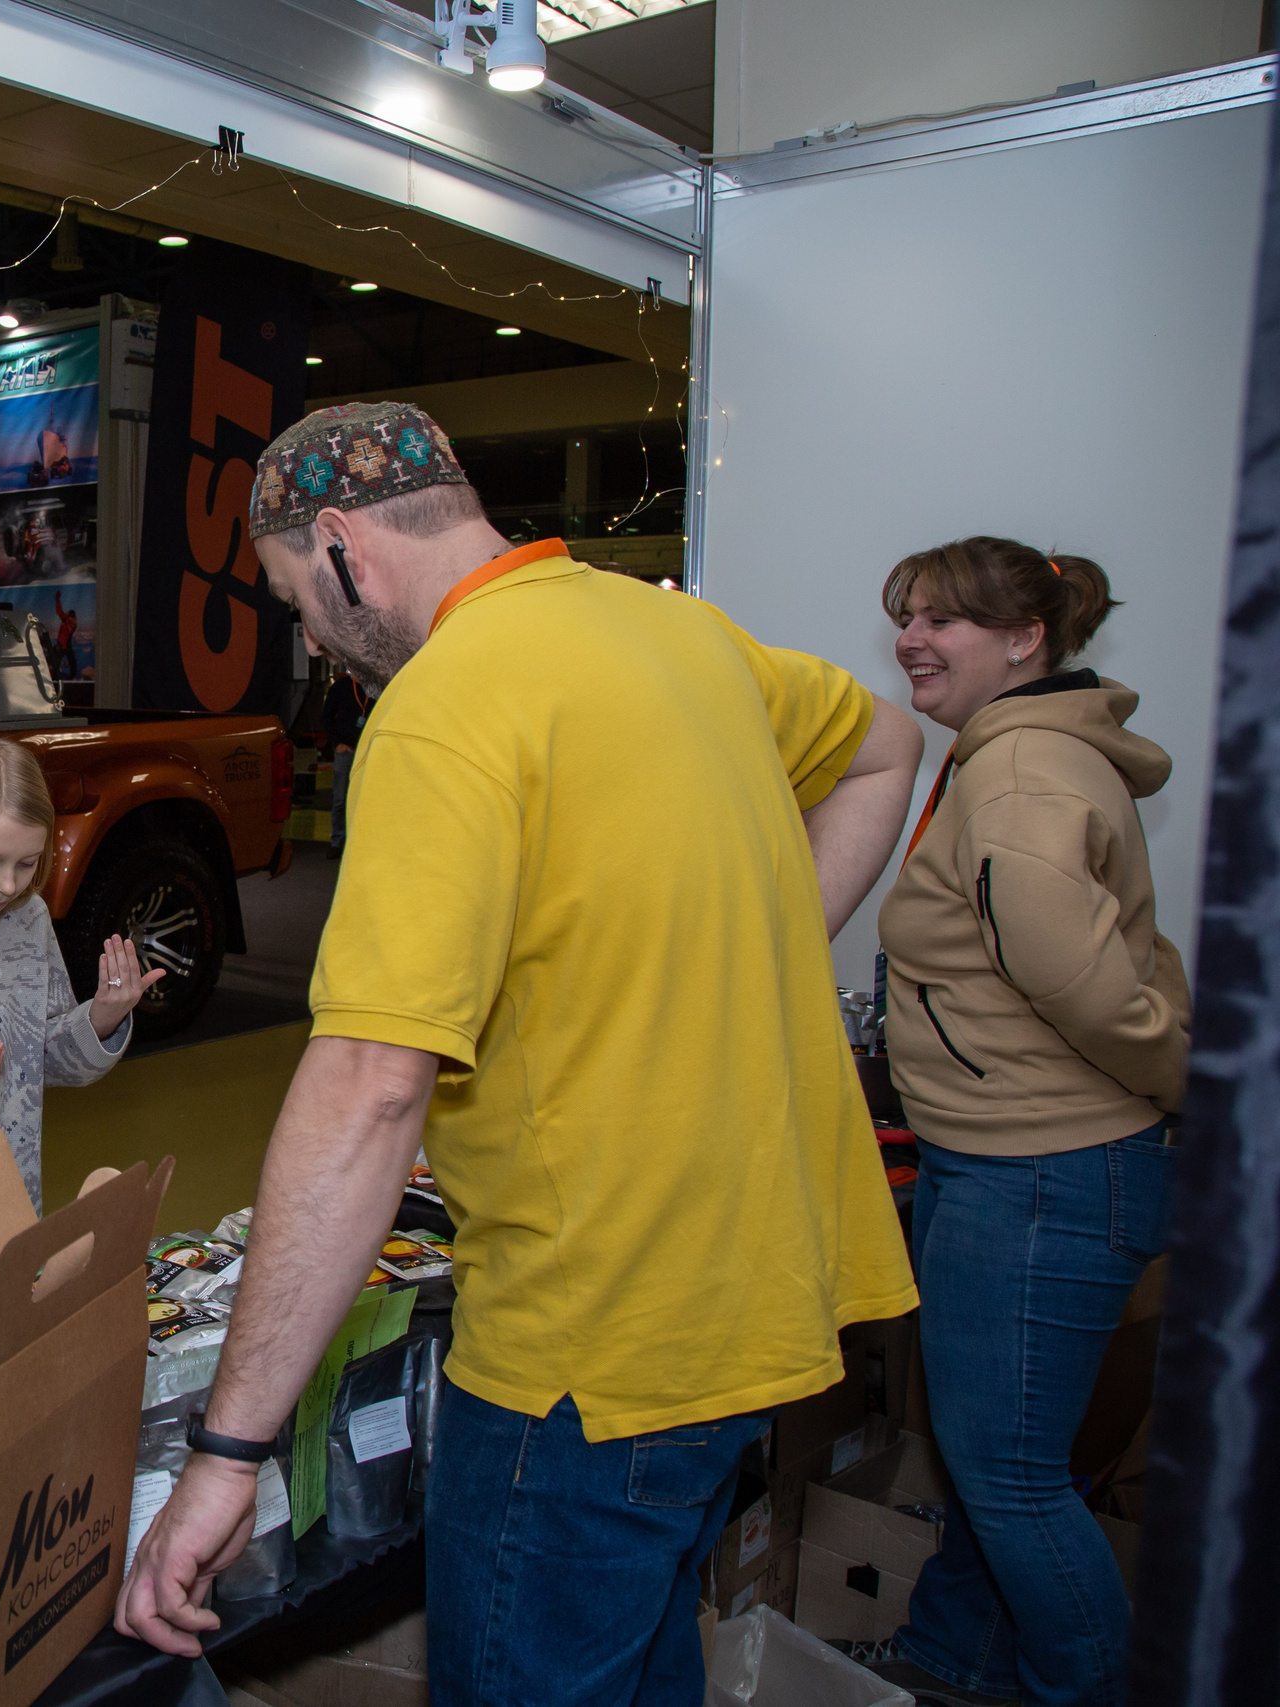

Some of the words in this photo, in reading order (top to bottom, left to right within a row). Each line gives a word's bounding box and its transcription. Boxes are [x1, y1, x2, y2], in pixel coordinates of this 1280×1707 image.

[178, 314, 273, 712] CST
[346, 1340, 355, 1363] ПОРТ
[8, 1506, 115, 1625] консервы
[11, 1557, 105, 1659] MOI-KONSERVY.RU
